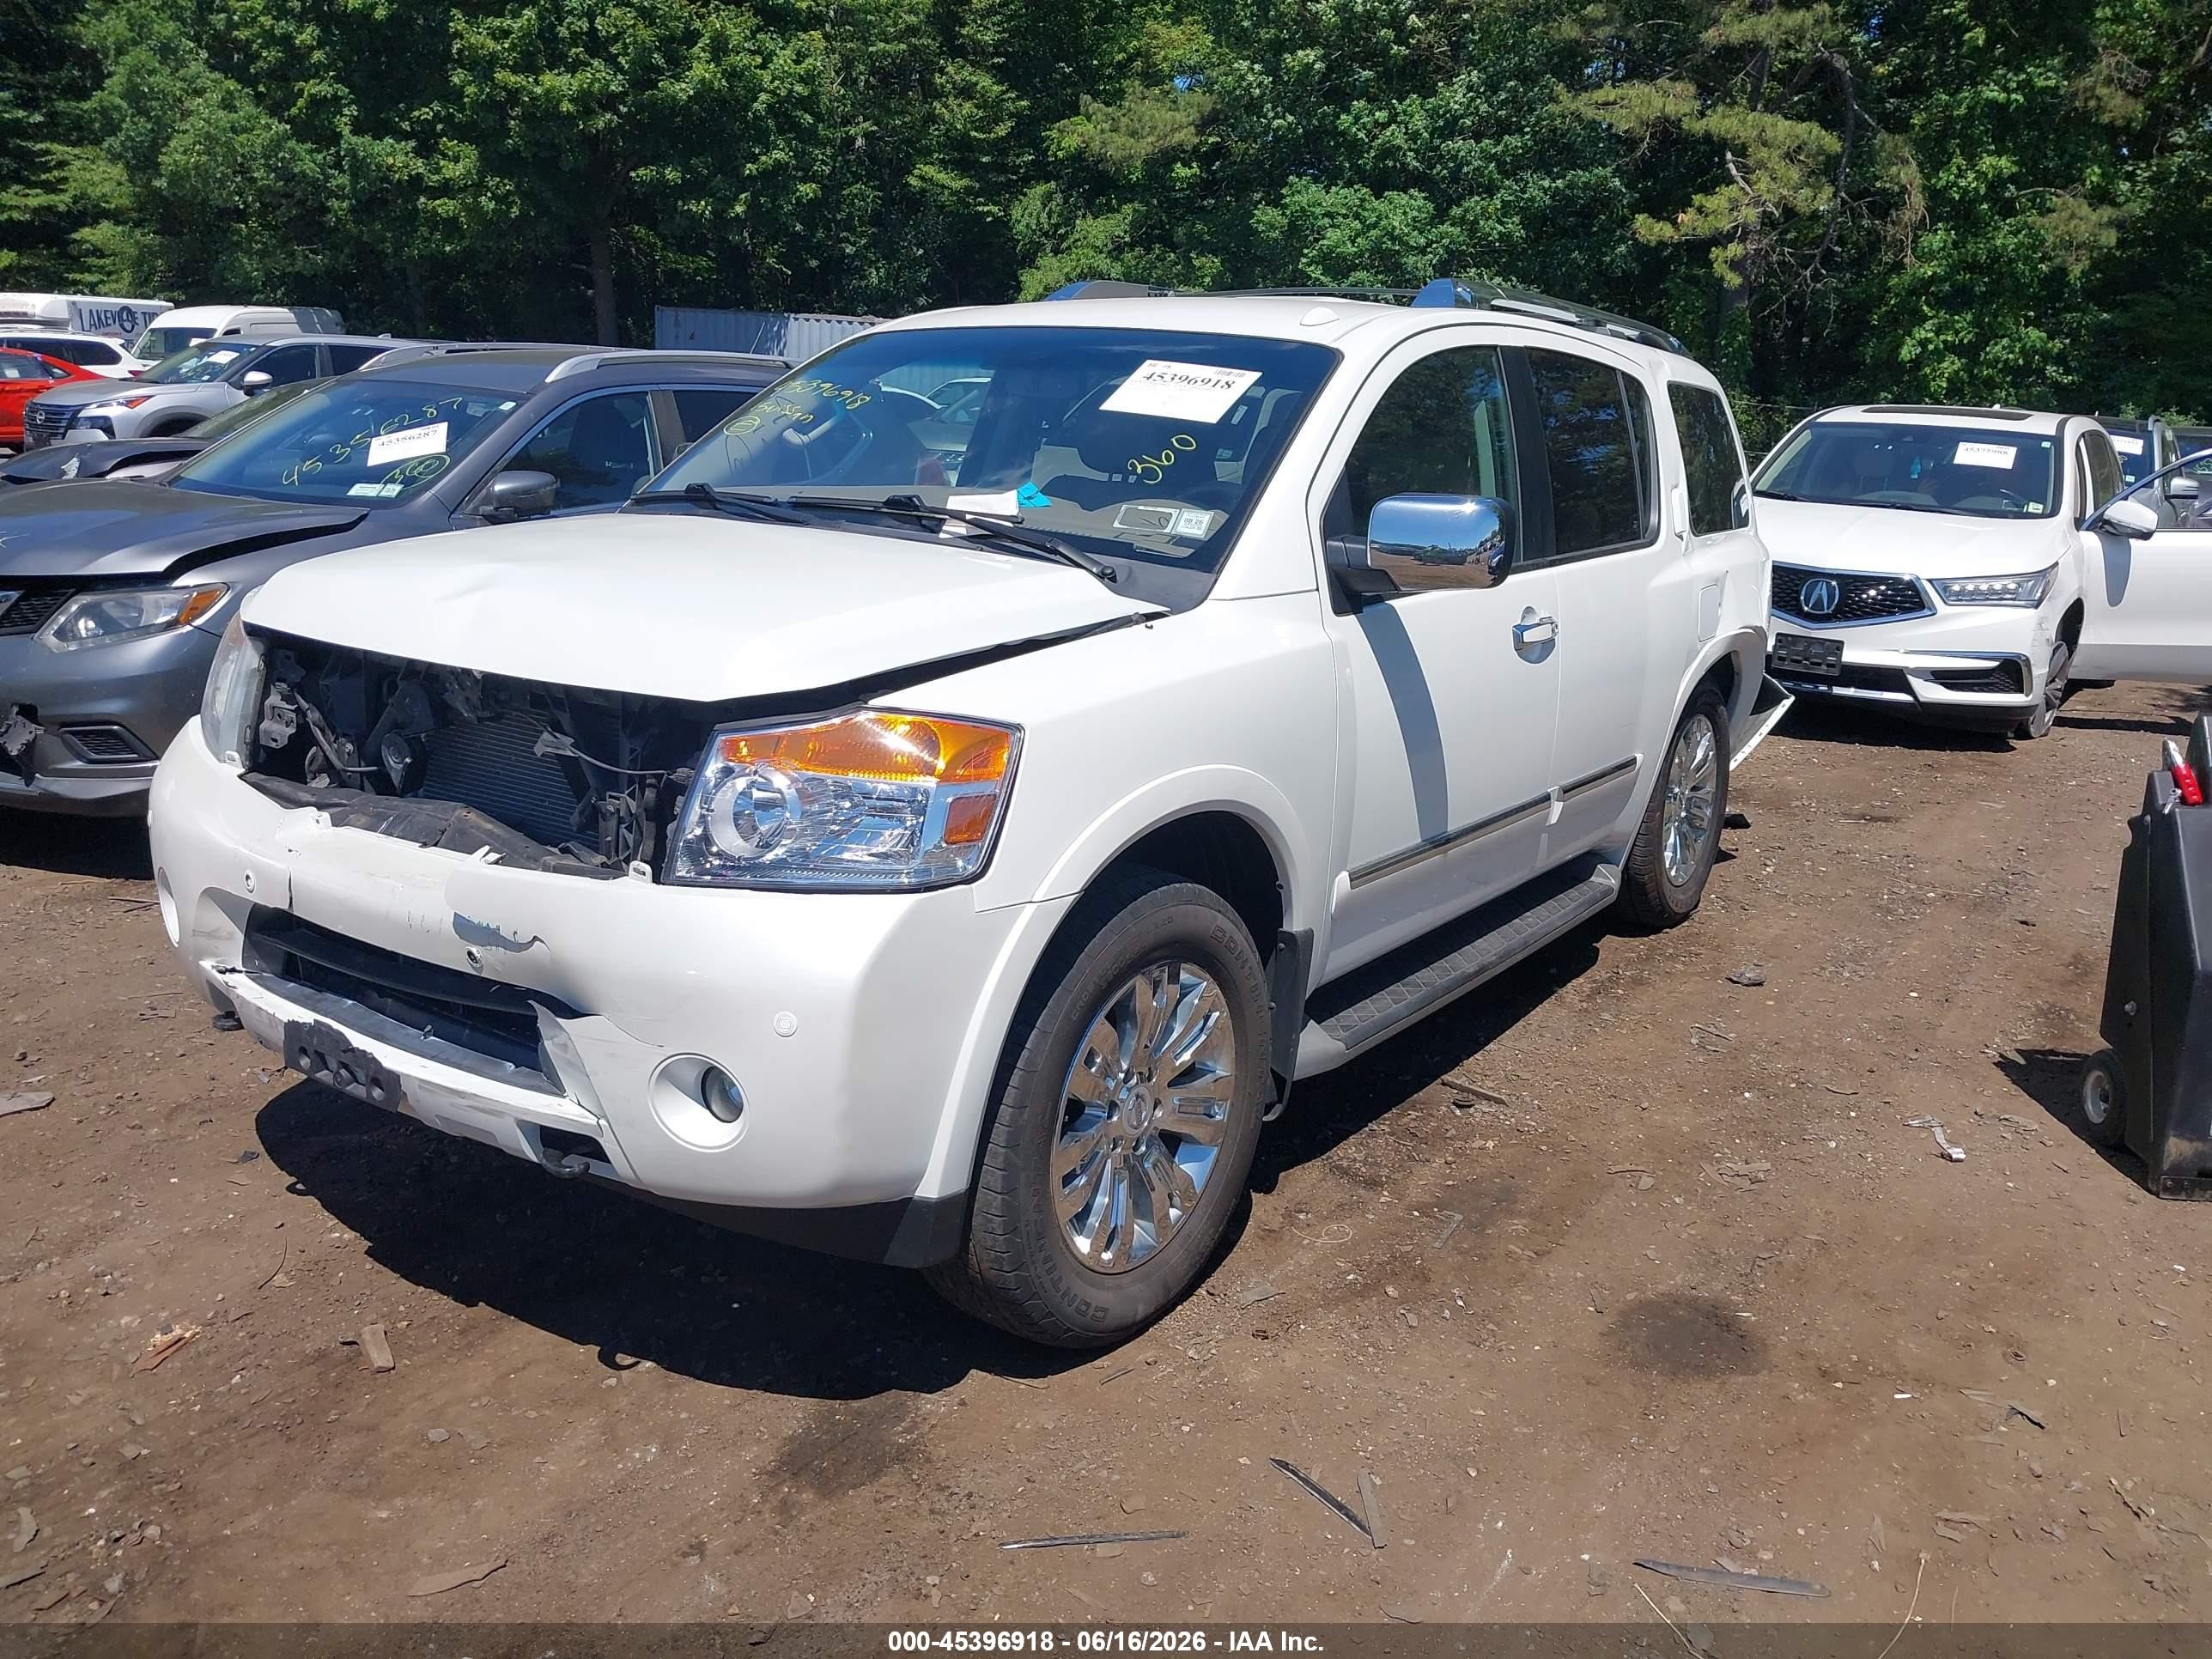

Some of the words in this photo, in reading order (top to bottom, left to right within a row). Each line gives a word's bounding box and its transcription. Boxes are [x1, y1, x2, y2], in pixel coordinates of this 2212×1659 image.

[770, 380, 872, 410] 45396918
[1143, 371, 1237, 390] 45396918
[1127, 434, 1196, 483] 360
